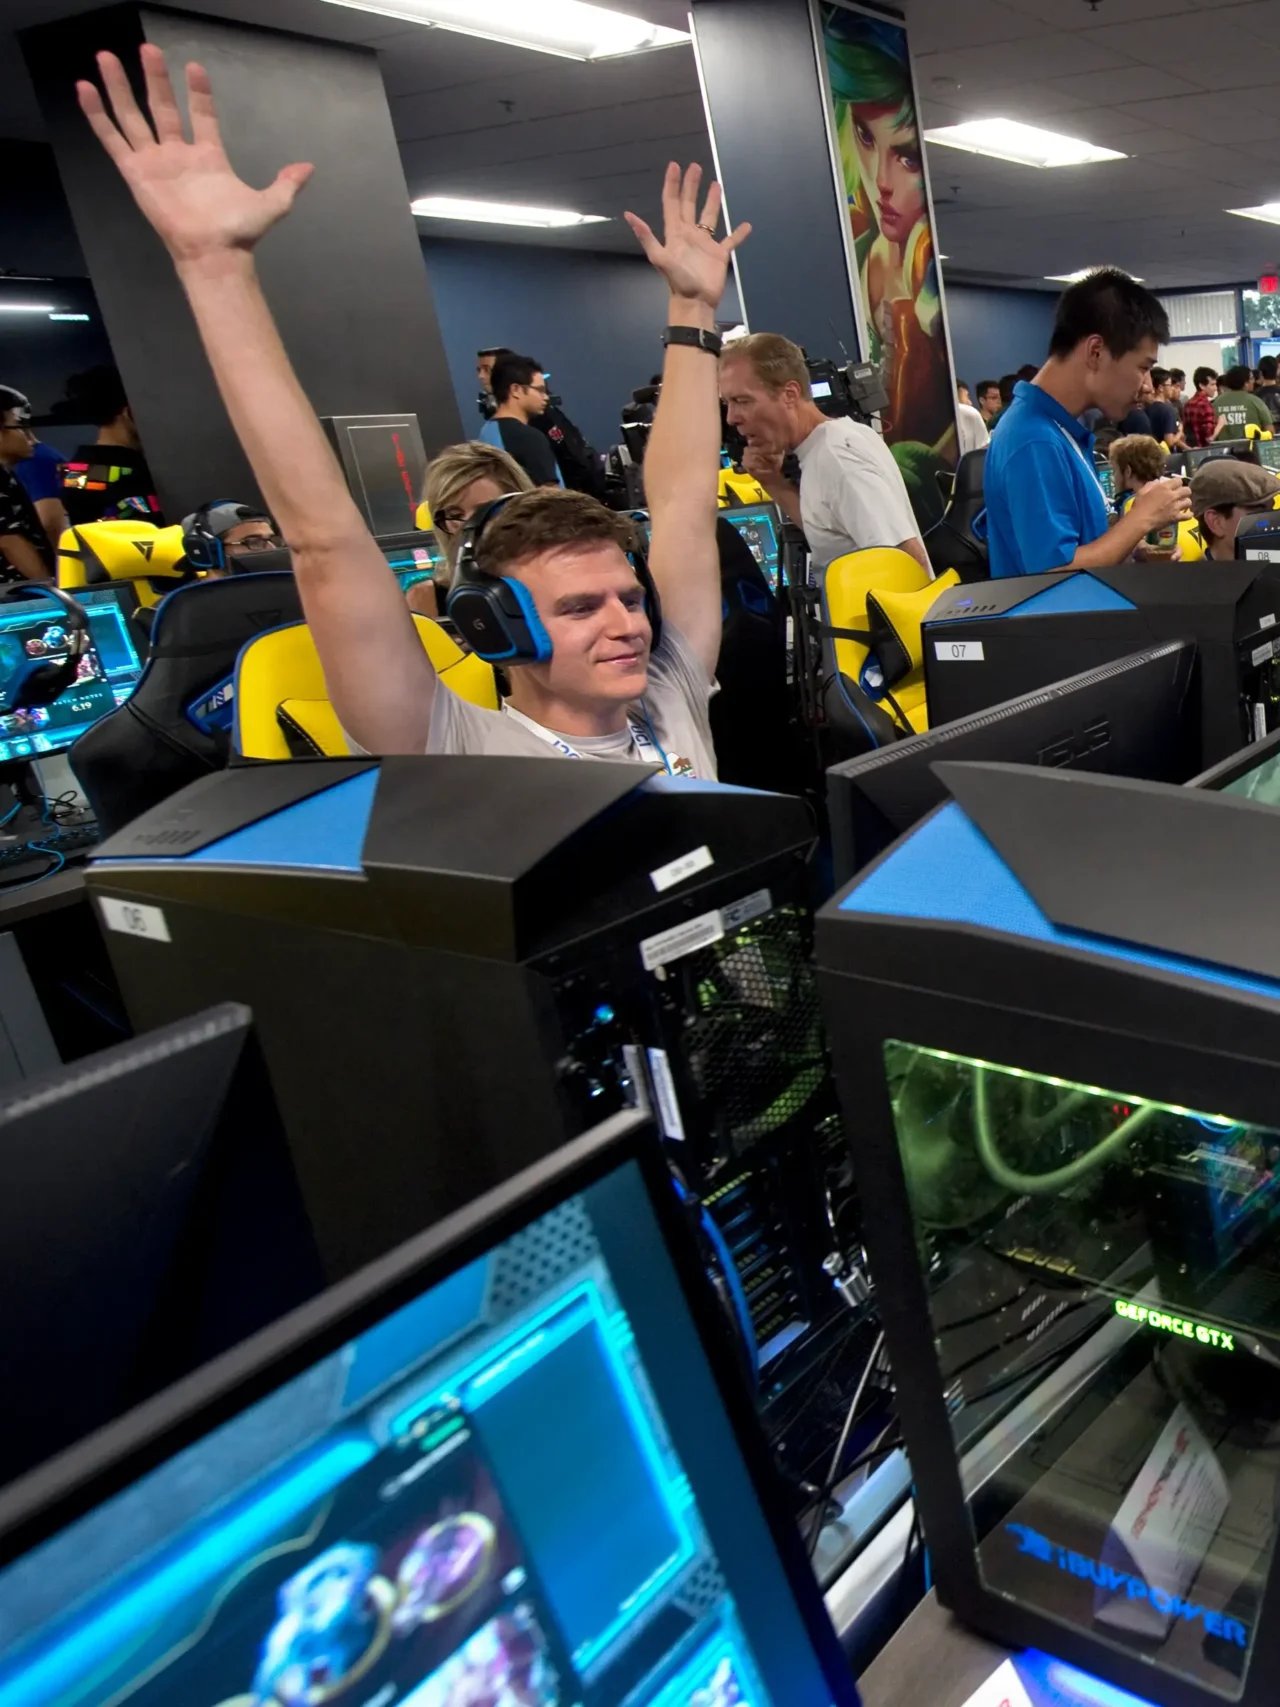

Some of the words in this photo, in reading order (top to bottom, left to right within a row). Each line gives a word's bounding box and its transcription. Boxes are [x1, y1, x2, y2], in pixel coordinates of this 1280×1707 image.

[1257, 551, 1269, 561] 08
[951, 644, 966, 658] 07
[71, 701, 92, 712] 6.19
[631, 724, 652, 748] UCI
[122, 905, 147, 932] 06
[1114, 1299, 1195, 1339] GEFORCE
[1195, 1325, 1235, 1351] GTX
